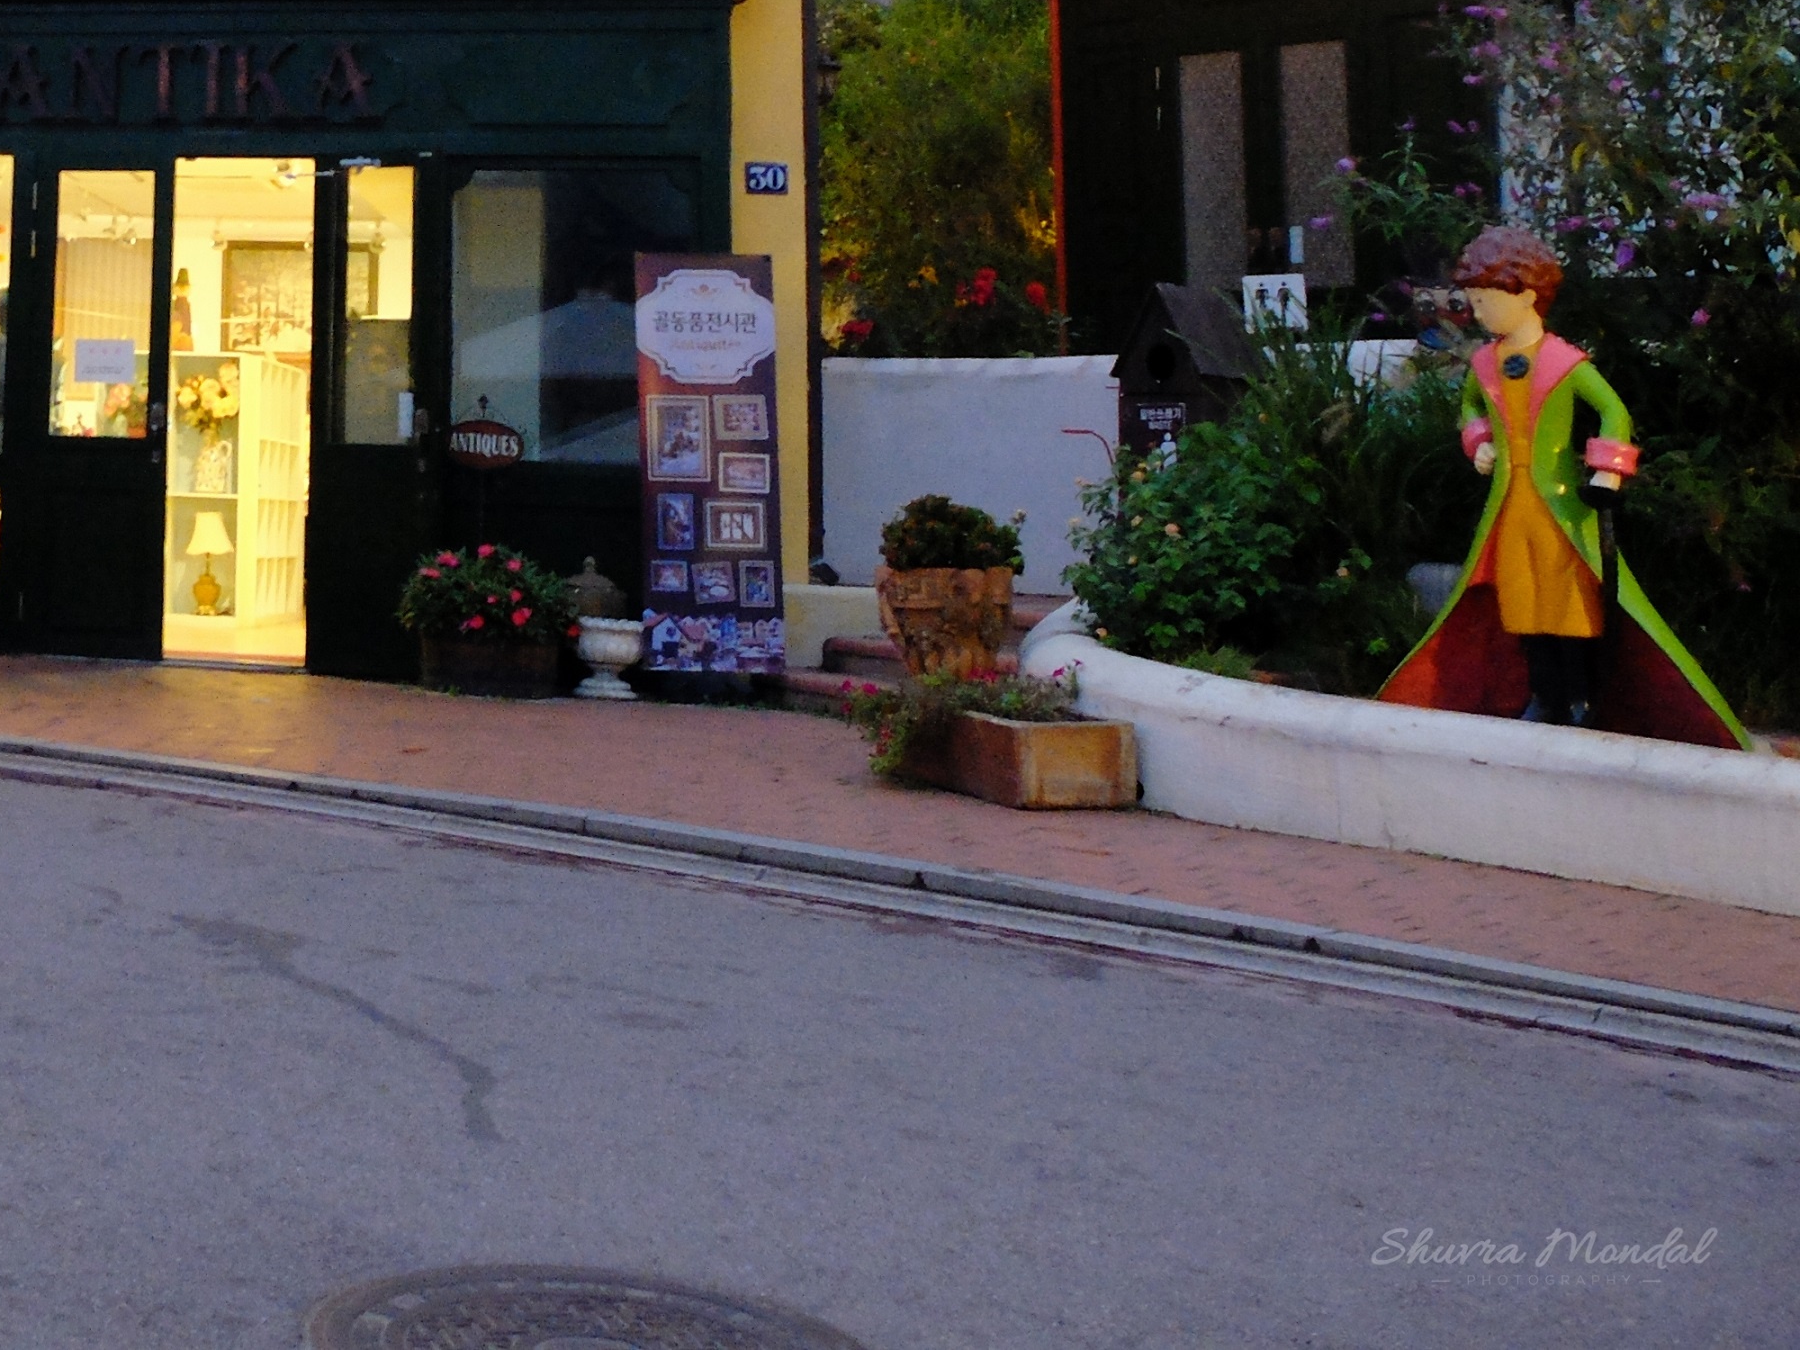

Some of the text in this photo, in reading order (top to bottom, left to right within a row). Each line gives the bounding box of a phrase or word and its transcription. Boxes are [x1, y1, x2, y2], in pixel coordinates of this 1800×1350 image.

[749, 165, 785, 191] 30
[653, 311, 757, 334] 골동품전시관
[449, 432, 520, 458] ANTIQUES
